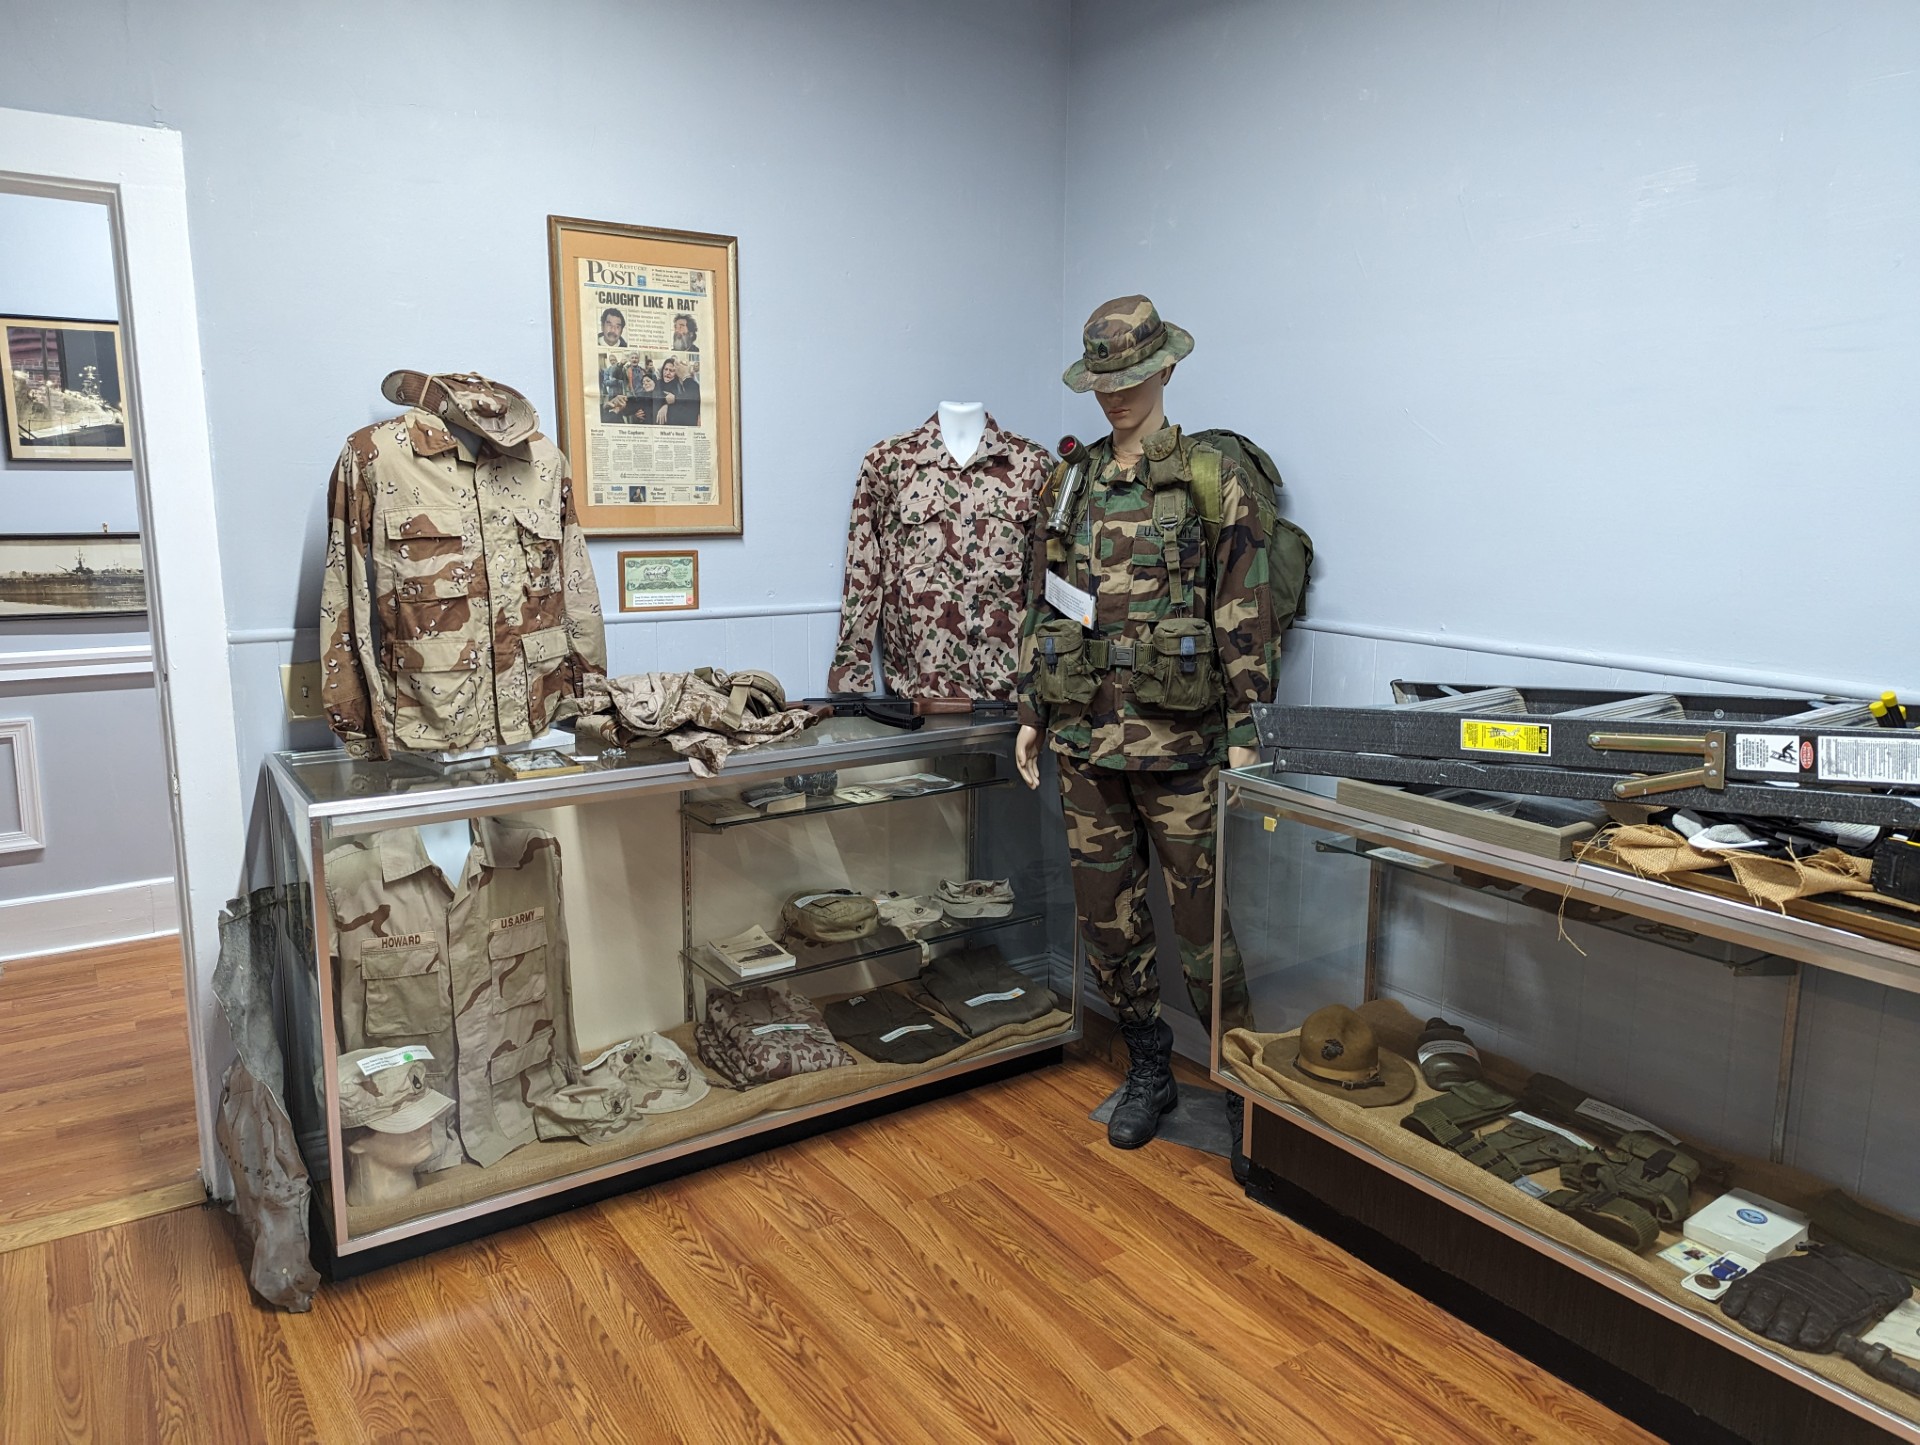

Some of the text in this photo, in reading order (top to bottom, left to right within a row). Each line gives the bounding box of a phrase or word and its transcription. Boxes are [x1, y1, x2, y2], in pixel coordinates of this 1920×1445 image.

[586, 260, 636, 286] POST
[643, 295, 664, 309] LIKE
[667, 297, 674, 310] A
[381, 934, 421, 949] HOWARD
